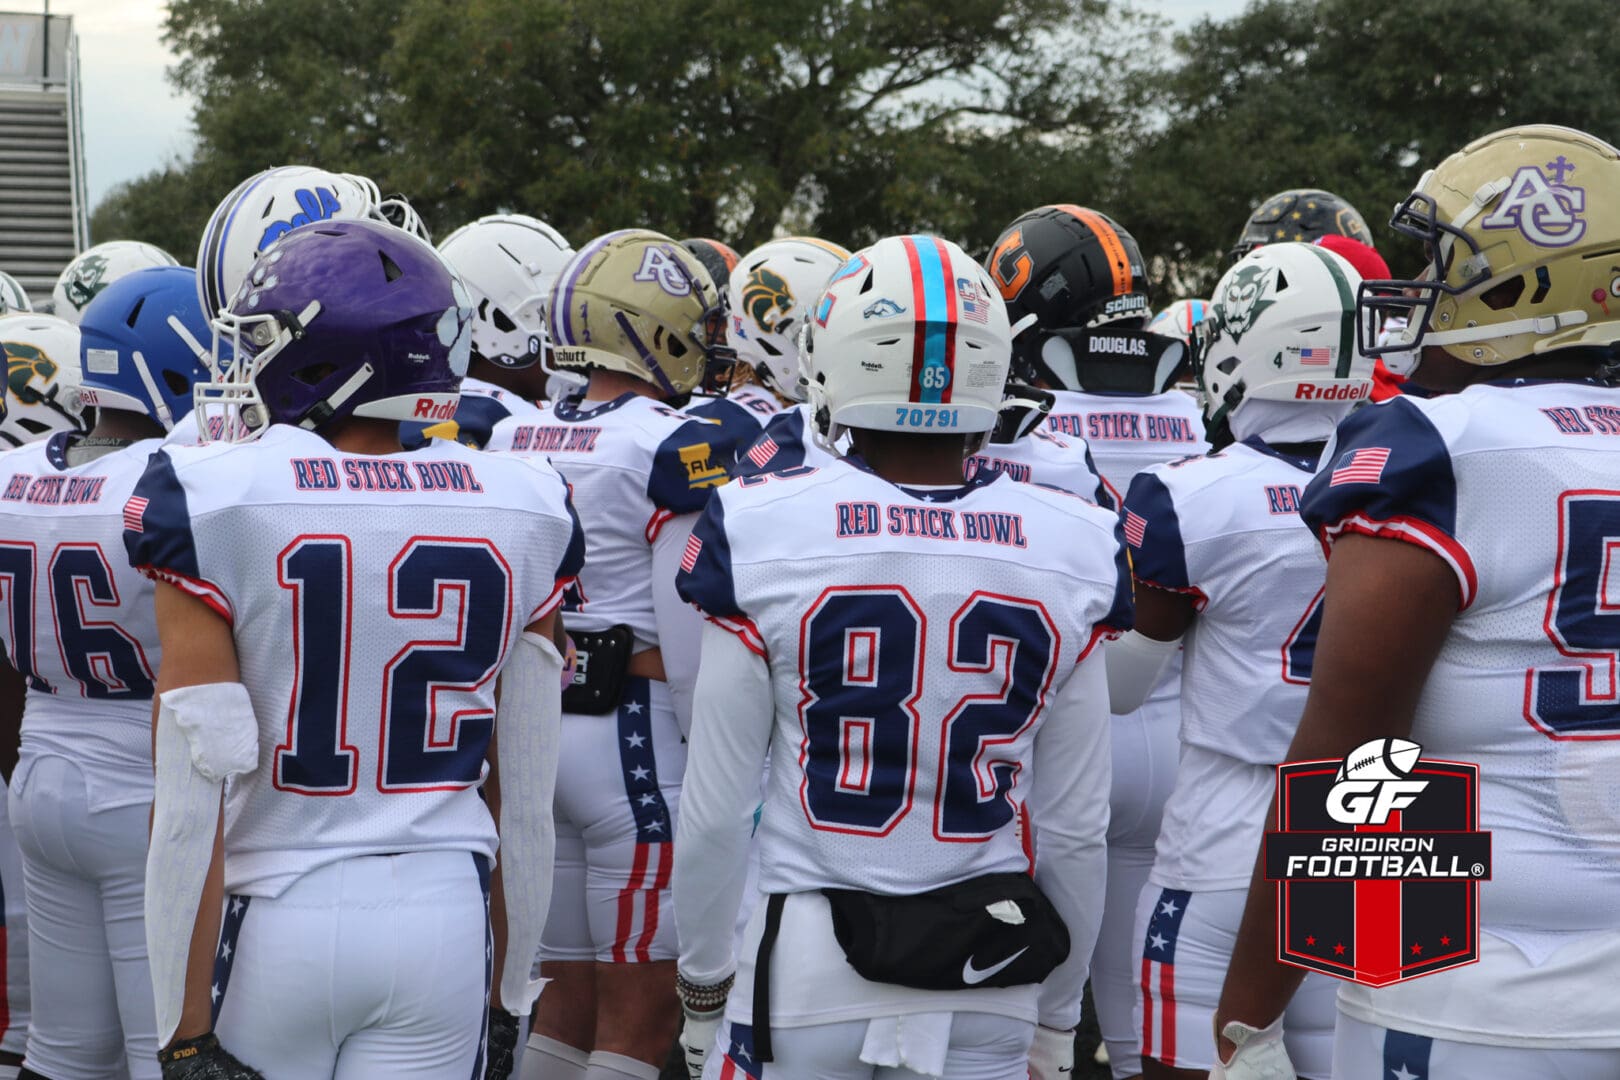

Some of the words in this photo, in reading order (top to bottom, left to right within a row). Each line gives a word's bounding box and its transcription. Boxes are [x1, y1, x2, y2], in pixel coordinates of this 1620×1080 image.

[1481, 166, 1587, 248] AC
[1089, 336, 1147, 355] DOUGLAS
[1274, 352, 1283, 368] 4
[923, 367, 945, 388] 85
[1295, 383, 1369, 400] Riddell
[896, 408, 958, 428] 70791
[1087, 412, 1144, 441] STICK
[1144, 413, 1197, 443] BOWL
[1538, 406, 1593, 435] RED
[510, 425, 535, 452] RED
[531, 425, 569, 452] STICK
[563, 427, 602, 453] BOWL
[2, 473, 33, 502] RED
[27, 474, 67, 505] STICK
[62, 475, 108, 505] BOWL
[290, 457, 341, 491] RED
[341, 458, 416, 492] STICK
[412, 461, 484, 493] BOWL
[836, 502, 881, 537] RED
[887, 504, 959, 541] STICK
[961, 511, 1027, 548] BOWL
[272, 534, 513, 797] 12
[797, 584, 1061, 843] 82
